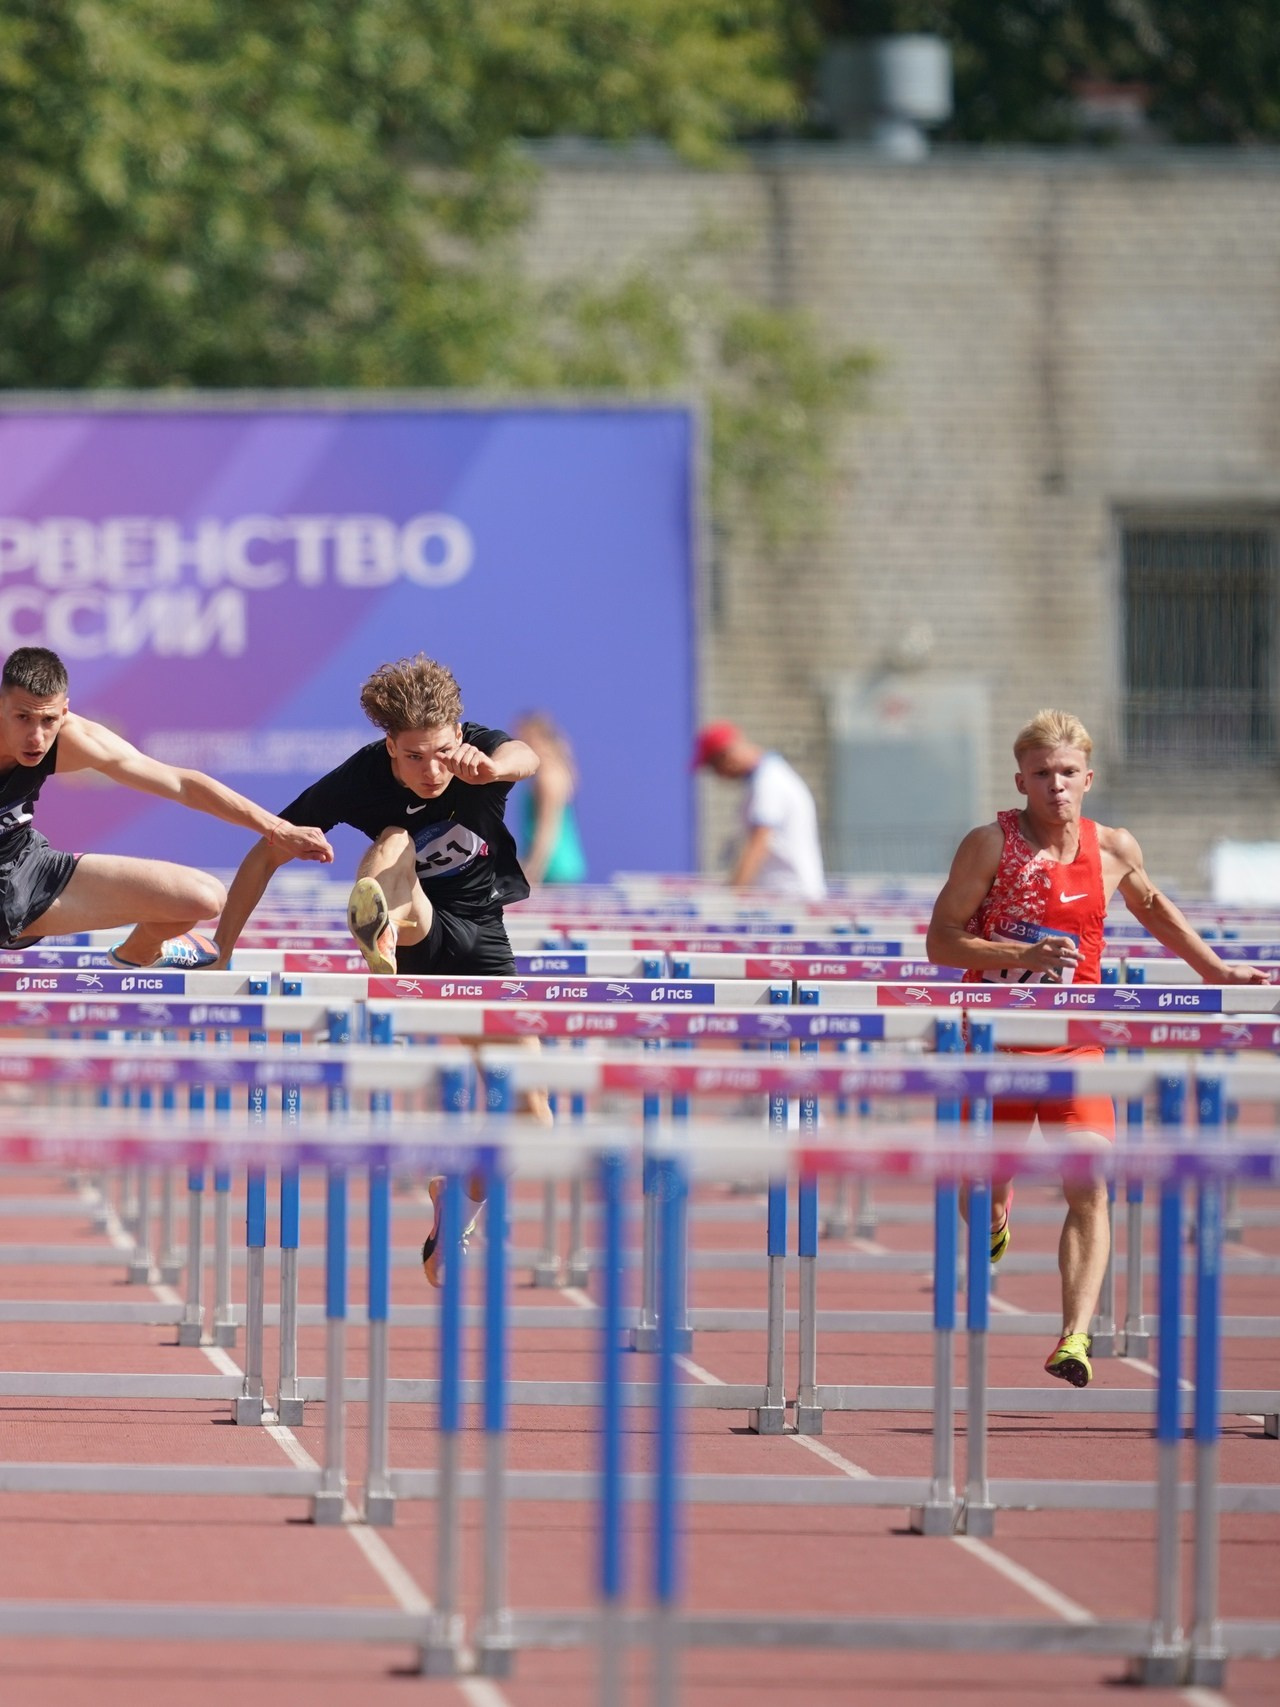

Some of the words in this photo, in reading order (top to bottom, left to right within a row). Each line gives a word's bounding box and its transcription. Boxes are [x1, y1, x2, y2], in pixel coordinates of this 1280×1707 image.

[999, 918, 1027, 936] U23
[32, 978, 58, 988] ПСБ
[137, 979, 163, 989] ПСБ
[457, 985, 483, 996] ПСБ
[562, 987, 588, 998] ПСБ
[667, 989, 693, 1000] ПСБ
[966, 993, 992, 1003] ПСБ
[1070, 993, 1096, 1004] ПСБ
[1174, 995, 1200, 1006] ПСБ
[253, 1087, 264, 1124] Sport
[287, 1089, 298, 1125] Sport
